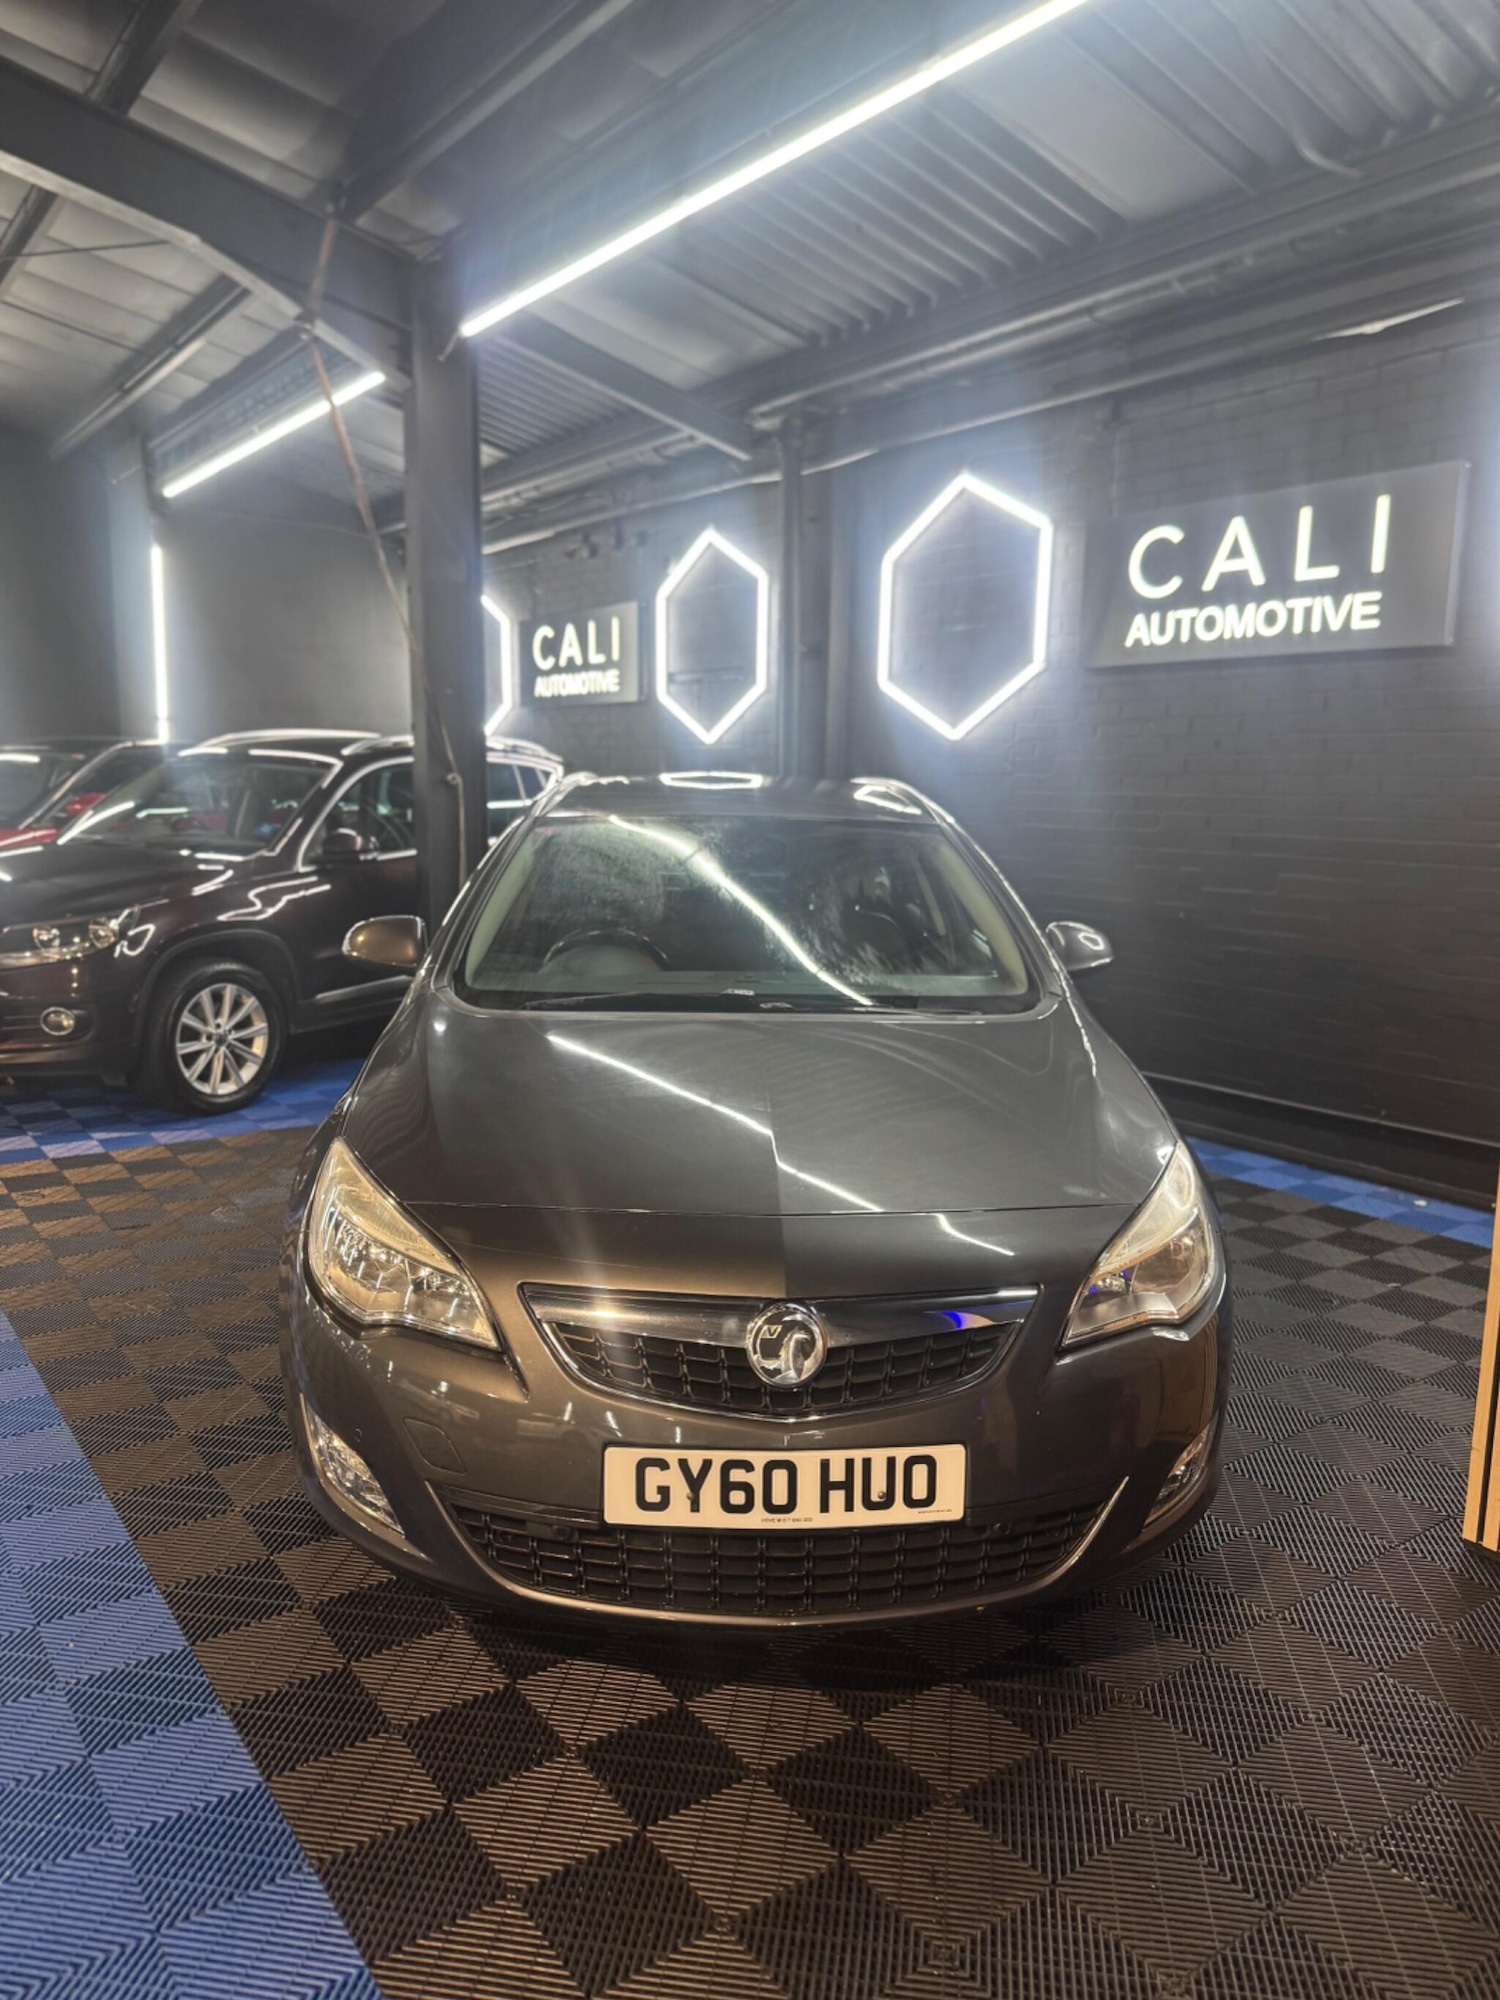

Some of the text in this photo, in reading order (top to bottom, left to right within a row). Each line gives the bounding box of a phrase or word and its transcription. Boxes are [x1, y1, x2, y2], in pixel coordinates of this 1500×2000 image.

[1127, 494, 1391, 599] CALI
[532, 616, 620, 671] CALI
[1124, 591, 1383, 648] AUTOMOTIVE
[635, 1454, 938, 1515] GY60 HUO
